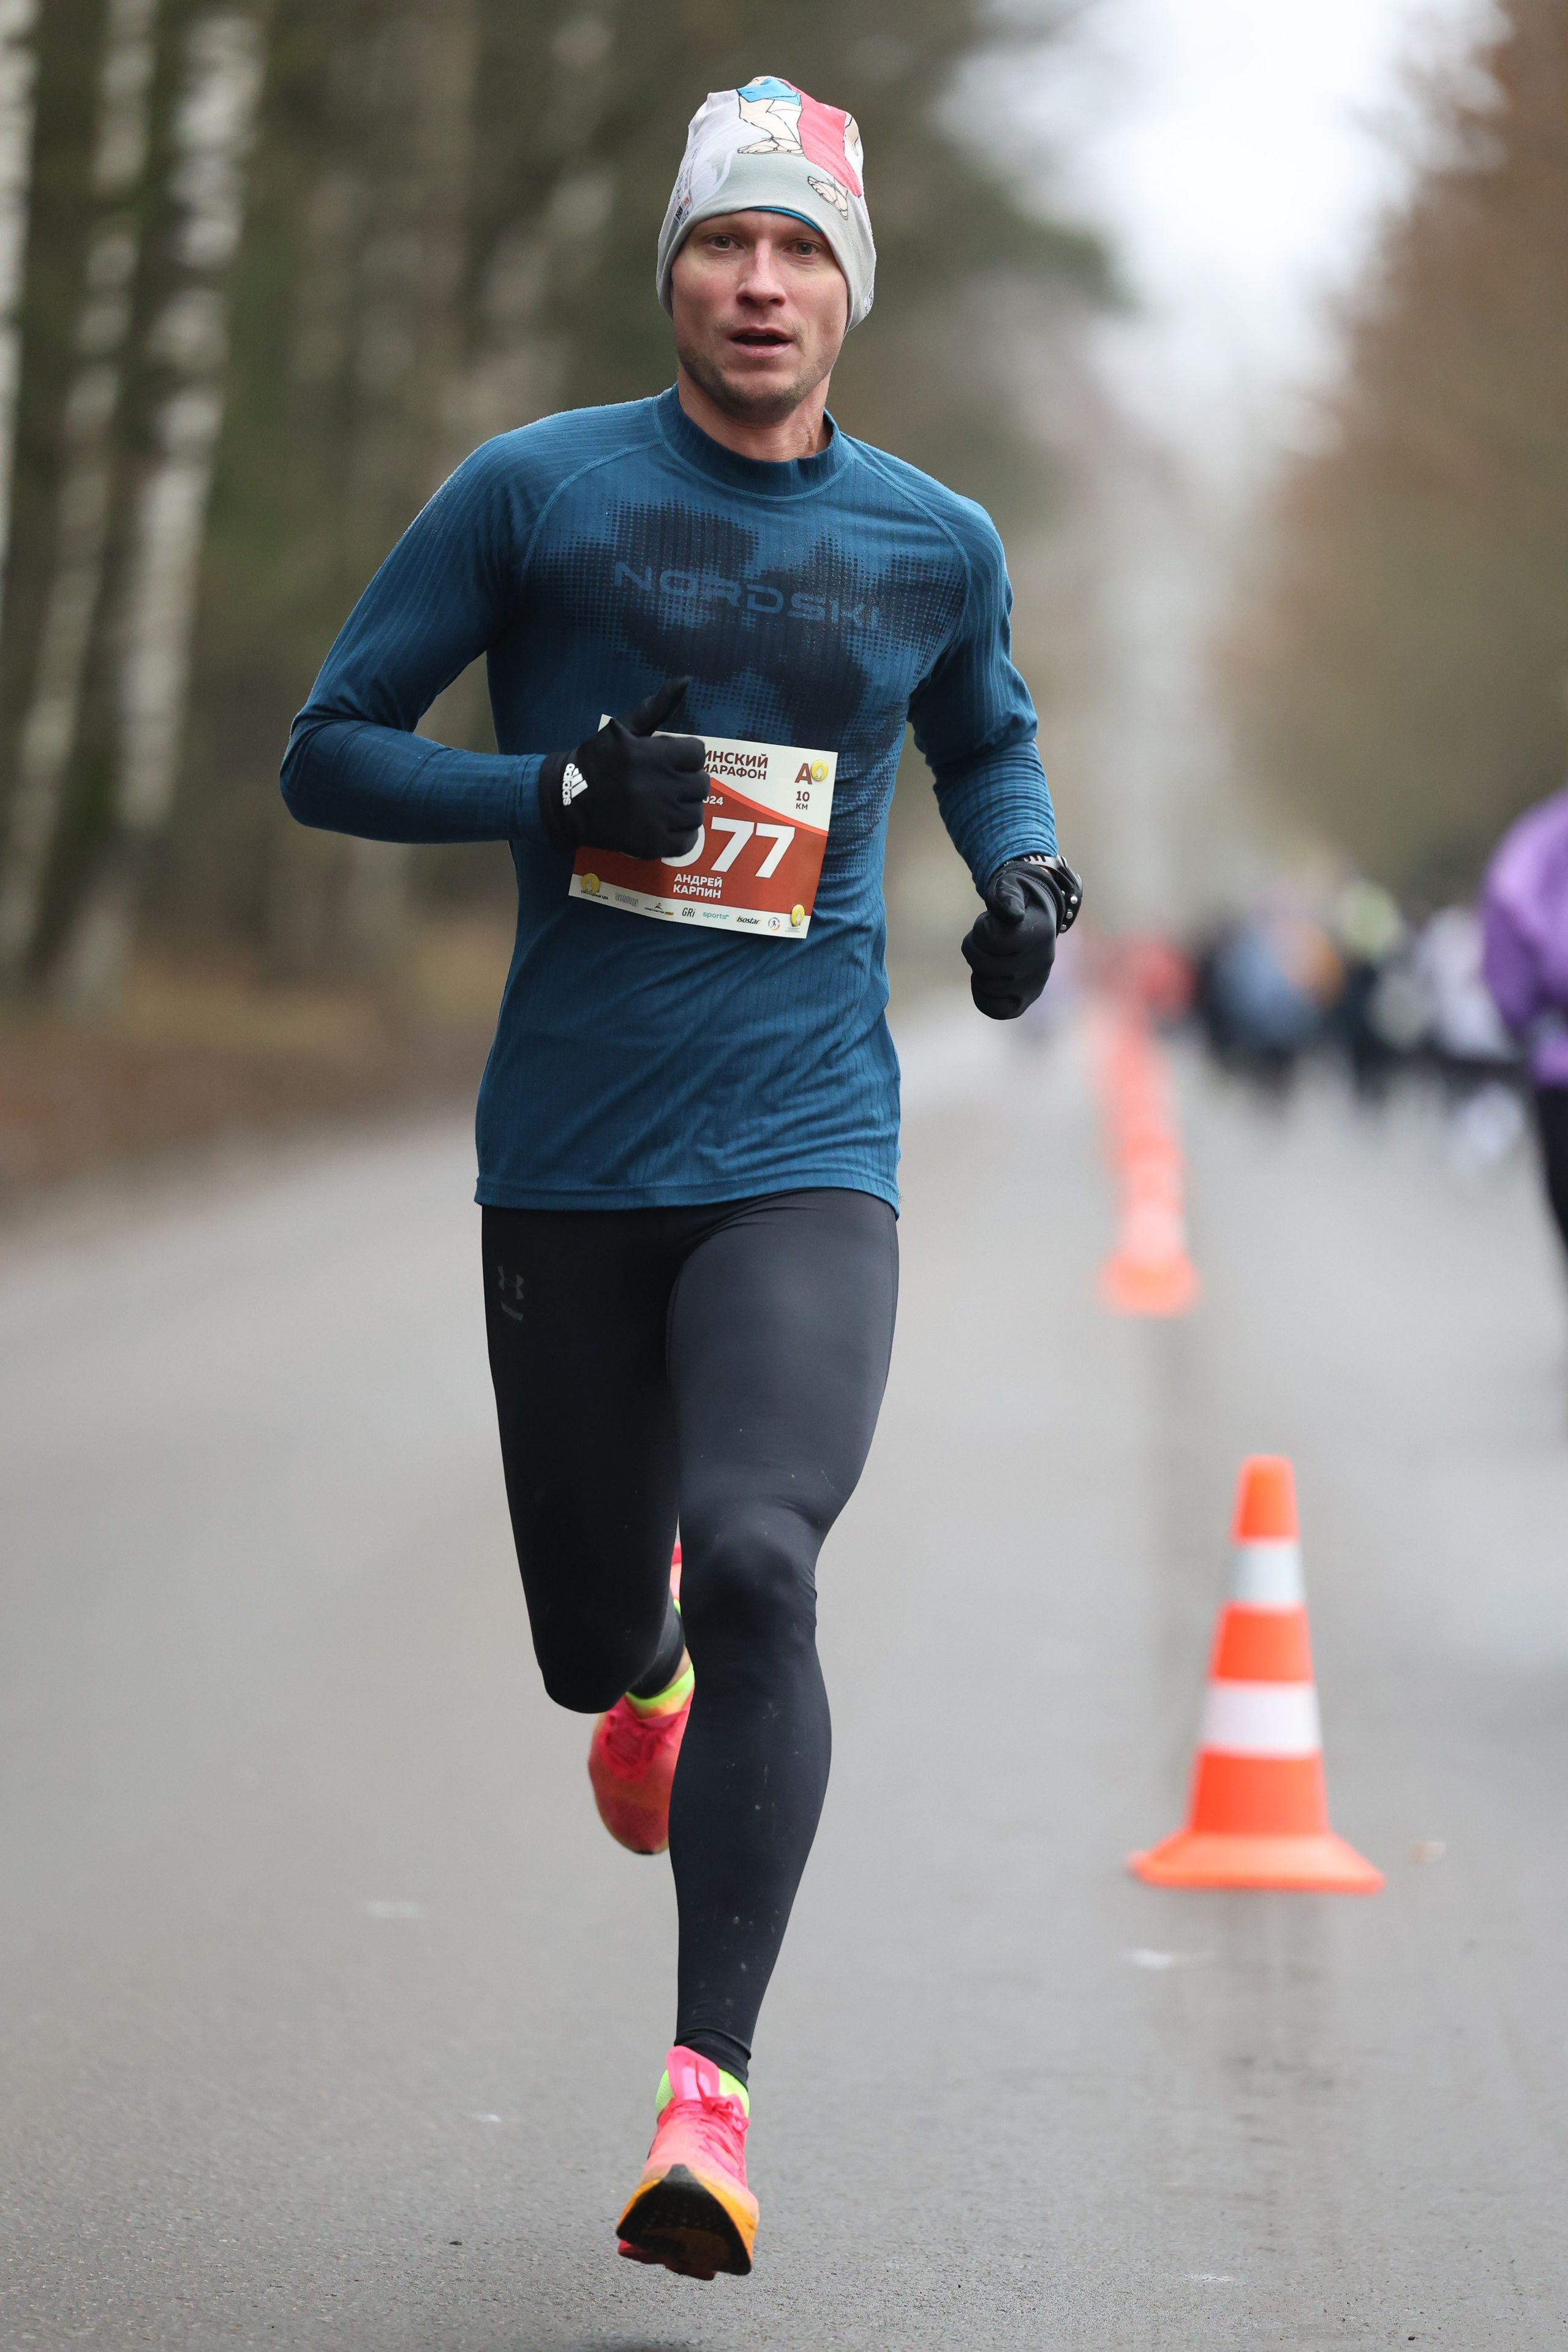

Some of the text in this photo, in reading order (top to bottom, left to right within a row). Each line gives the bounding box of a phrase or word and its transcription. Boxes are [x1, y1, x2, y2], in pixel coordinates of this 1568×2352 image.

[613, 560, 880, 628] NORDSKI
[562, 763, 576, 807] adidas
[796, 791, 810, 802] 10
[674, 873, 723, 888] АНДРЕЙ
[673, 884, 722, 899] КАРПИН
